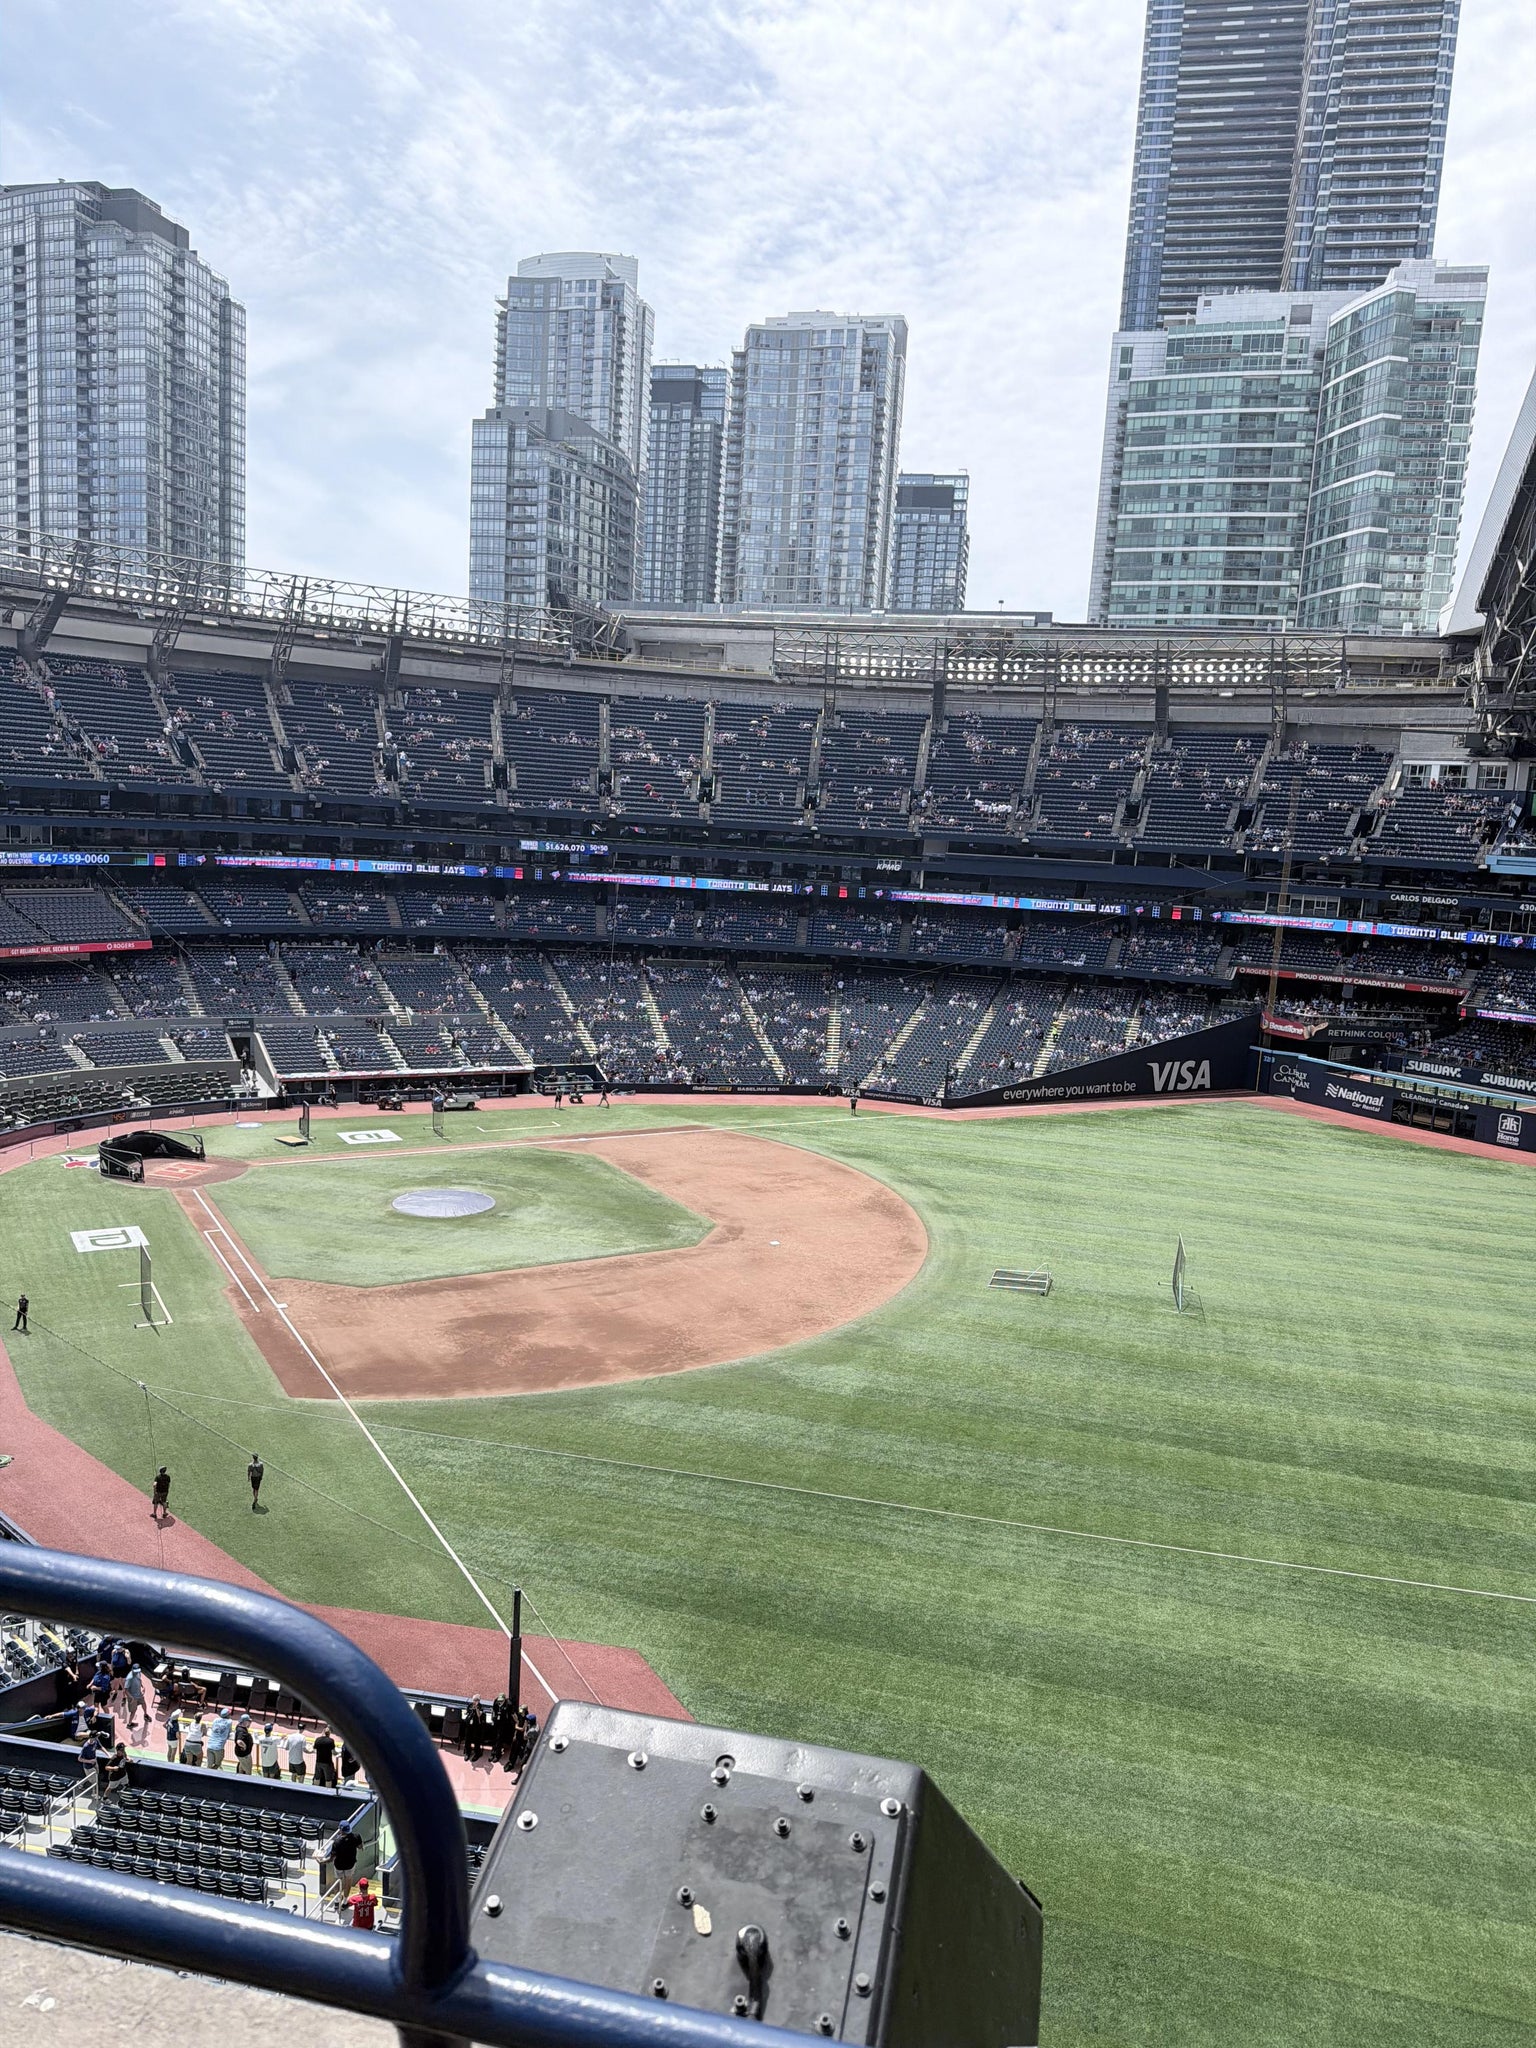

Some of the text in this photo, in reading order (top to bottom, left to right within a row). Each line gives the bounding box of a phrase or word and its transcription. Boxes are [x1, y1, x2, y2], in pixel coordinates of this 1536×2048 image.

[38, 853, 110, 864] 647-559-0060
[371, 862, 465, 874] TORONTO BLUE JAYS
[876, 862, 901, 871] KPMG
[706, 880, 793, 893] TORONTO BLUE JAYS
[1390, 893, 1458, 906] CARLOS DELGADO
[1030, 900, 1121, 914] TORONTO BLUE JAYS
[1390, 926, 1497, 944] TORONTO BLUE JAYS
[1246, 967, 1269, 976] ROGERS
[1295, 972, 1317, 980] PROUD
[1319, 975, 1342, 983] OWNER
[1429, 986, 1454, 995] ROGERS
[1328, 1029, 1404, 1040] RETHINK COLOUR
[1406, 1060, 1462, 1078] SUBWAY
[1146, 1060, 1211, 1092] VISA
[1480, 1073, 1536, 1091] SUBWAY
[841, 1087, 861, 1097] VISA
[1003, 1080, 1136, 1100] everywhere you want to be
[921, 1096, 942, 1107] VISA
[1400, 1091, 1464, 1110] CLEAResult Canada
[1361, 1103, 1380, 1112] Rental
[1497, 1132, 1520, 1143] Home
[262, 1745, 268, 1754] 7
[359, 1906, 369, 1918] 11
